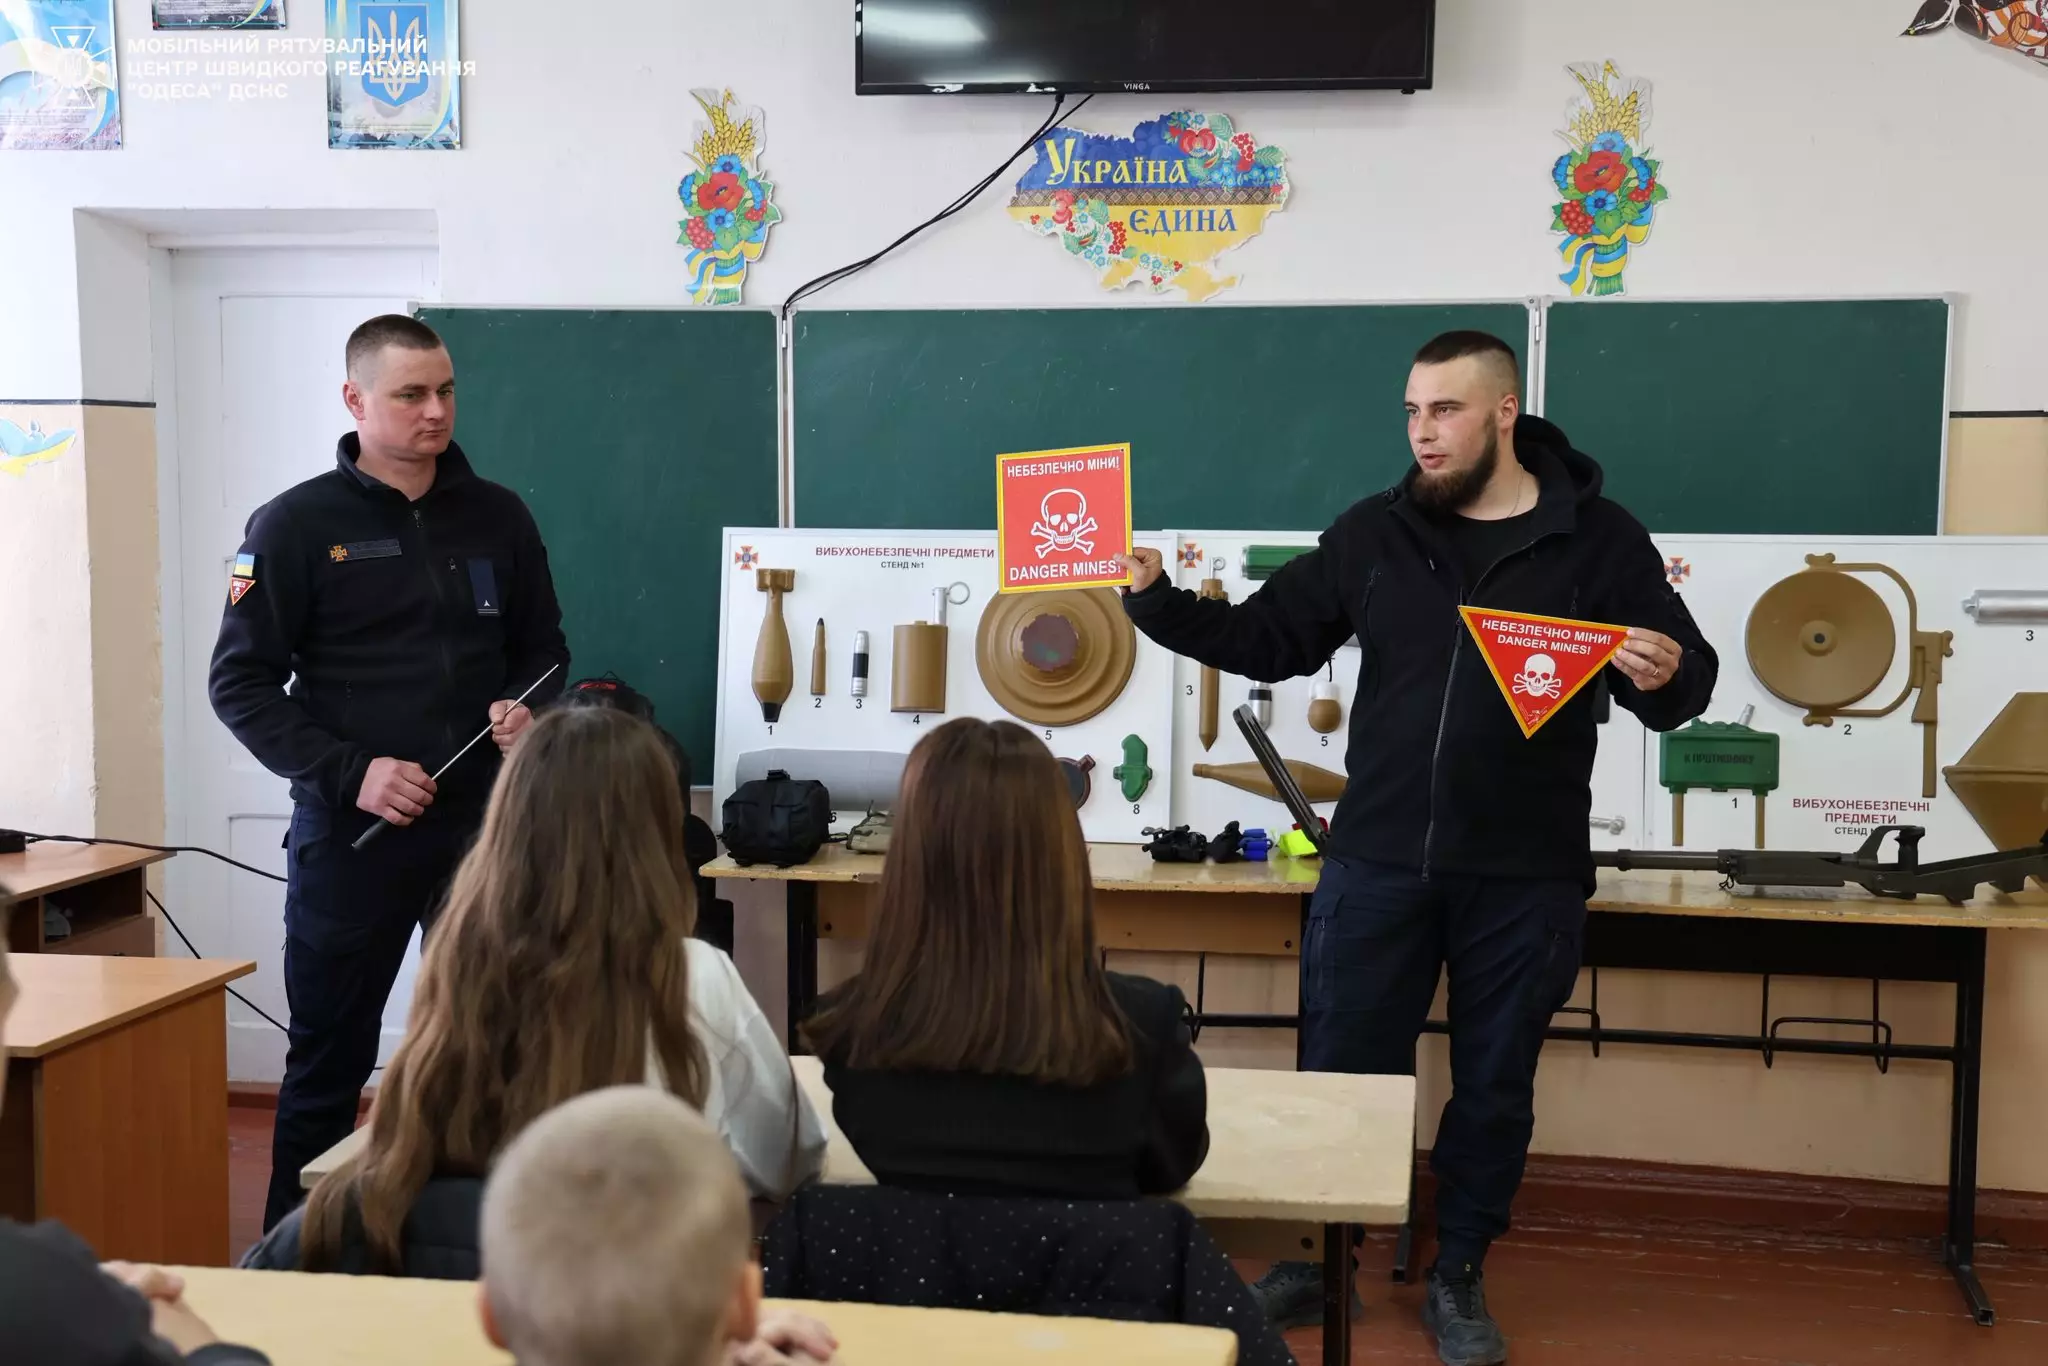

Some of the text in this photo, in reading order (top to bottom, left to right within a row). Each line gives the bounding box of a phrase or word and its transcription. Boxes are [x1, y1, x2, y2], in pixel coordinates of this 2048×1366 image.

[1129, 208, 1238, 237] ЄДИНА
[1007, 456, 1120, 478] НЕБЕЗПЕЧНО МІНИ!
[815, 547, 995, 558] ВИБУХОНЕБЕЗПЕЧНІ ПРЕДМЕТИ
[880, 561, 925, 569] СТЕНД №1
[1009, 563, 1069, 581] DANGER
[1482, 619, 1612, 645] НЕБЕЗПЕЧНО МІНИ!
[2026, 630, 2034, 641] 3
[1497, 635, 1591, 655] DANGER MINES!
[1186, 685, 1193, 696] 3
[814, 698, 821, 708] 2
[855, 699, 862, 709] 3
[913, 715, 920, 725] 4
[767, 725, 773, 735] 1
[1045, 730, 1052, 740] 5
[1844, 724, 1851, 735] 2
[1321, 736, 1328, 747] 5
[1731, 797, 1738, 808] 1
[1793, 799, 1930, 812] ВИБУХОНЕБЕЗПЕЧНІ
[1133, 804, 1140, 815] 8
[1825, 813, 1897, 824] ПРЕДМЕТИ
[1835, 827, 1868, 836] СТЕНД
